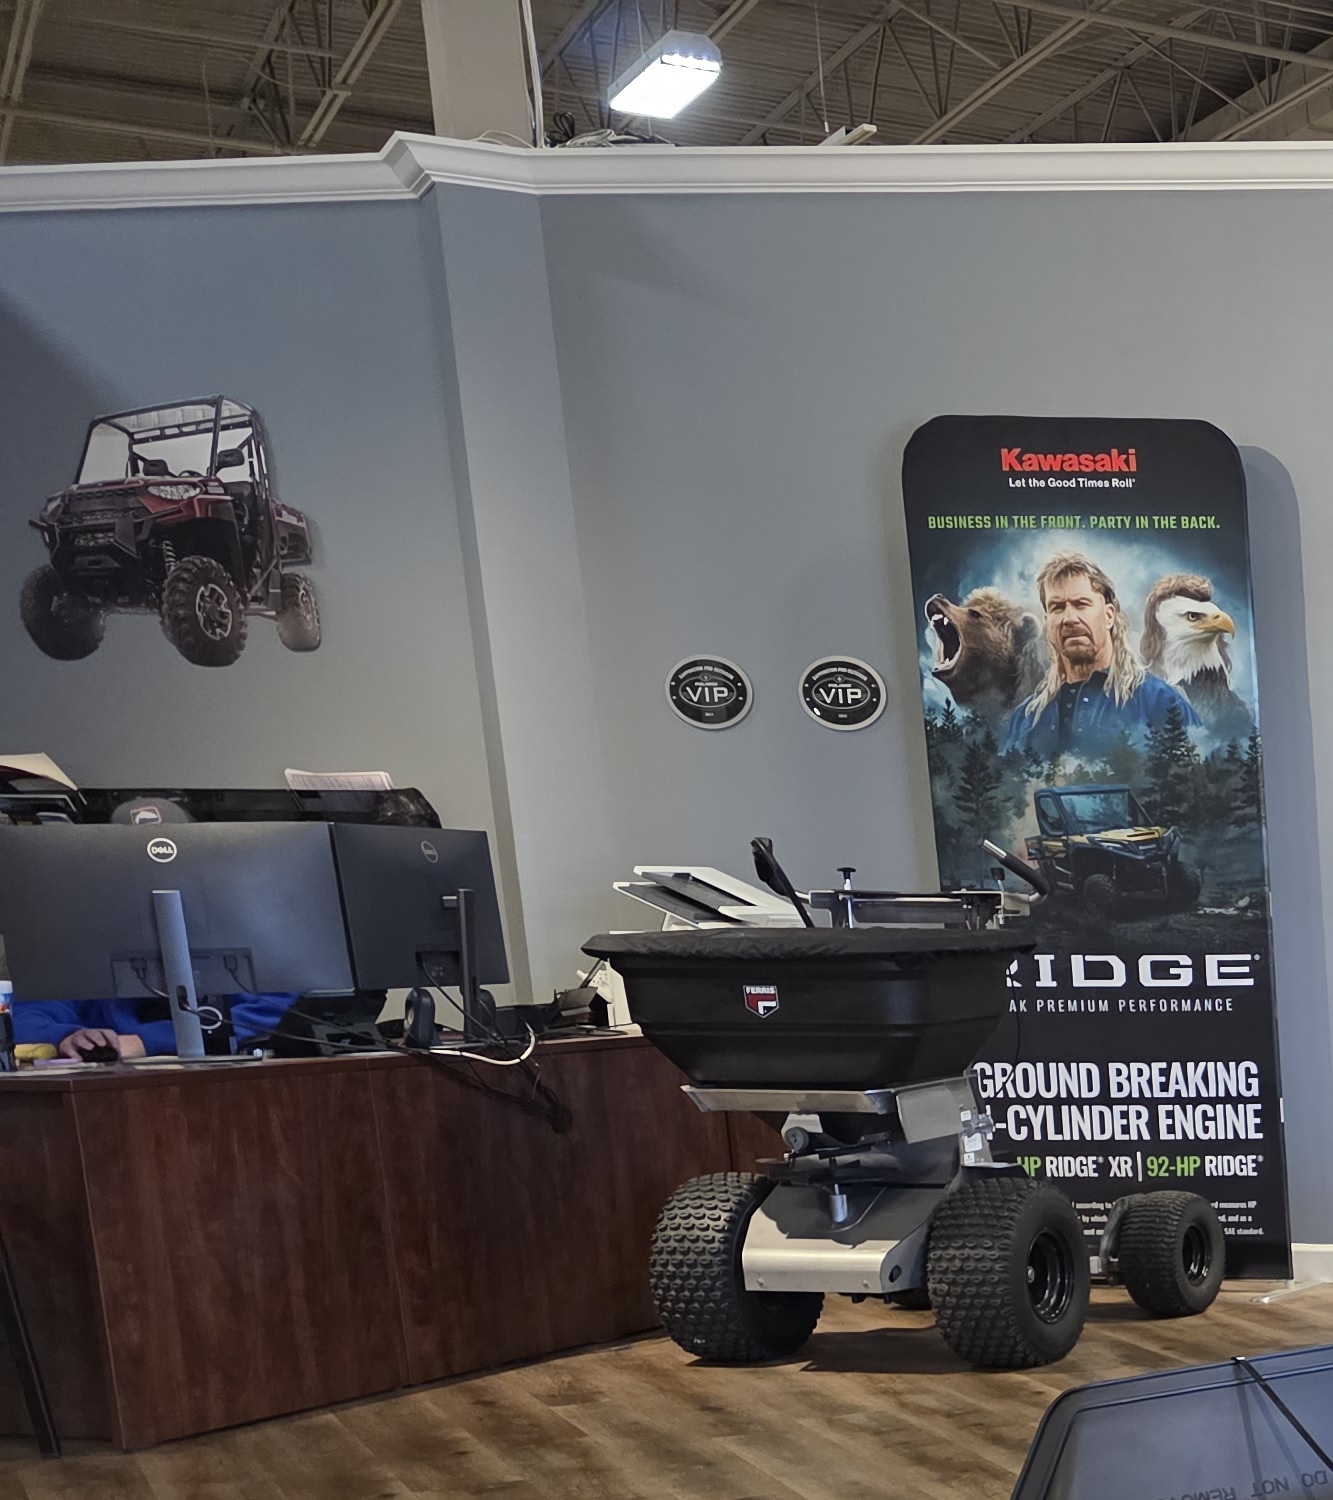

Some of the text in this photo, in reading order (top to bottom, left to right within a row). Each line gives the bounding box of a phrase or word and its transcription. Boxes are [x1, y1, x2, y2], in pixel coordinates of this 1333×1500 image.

[1001, 448, 1136, 472] Kawasaki
[1009, 477, 1026, 488] Let
[1029, 477, 1045, 488] the
[1048, 477, 1076, 488] Good
[1078, 478, 1109, 488] Times
[928, 515, 1220, 529] BUSINESS IN THE FRONT. PARTY IN THE BACK.
[686, 686, 729, 702] VIP
[819, 687, 862, 704] VIP
[151, 846, 174, 854] DELL
[1037, 999, 1109, 1013] PREMIUM
[1119, 998, 1234, 1012] PERFORMANCE
[973, 1061, 1259, 1098] GROUND BREAKING
[1158, 1104, 1263, 1140] ENGINE
[1108, 1156, 1133, 1177] XR
[1146, 1156, 1201, 1177] 92-HP
[1251, 1476, 1290, 1498] NOT
[1301, 1470, 1328, 1488] DO
